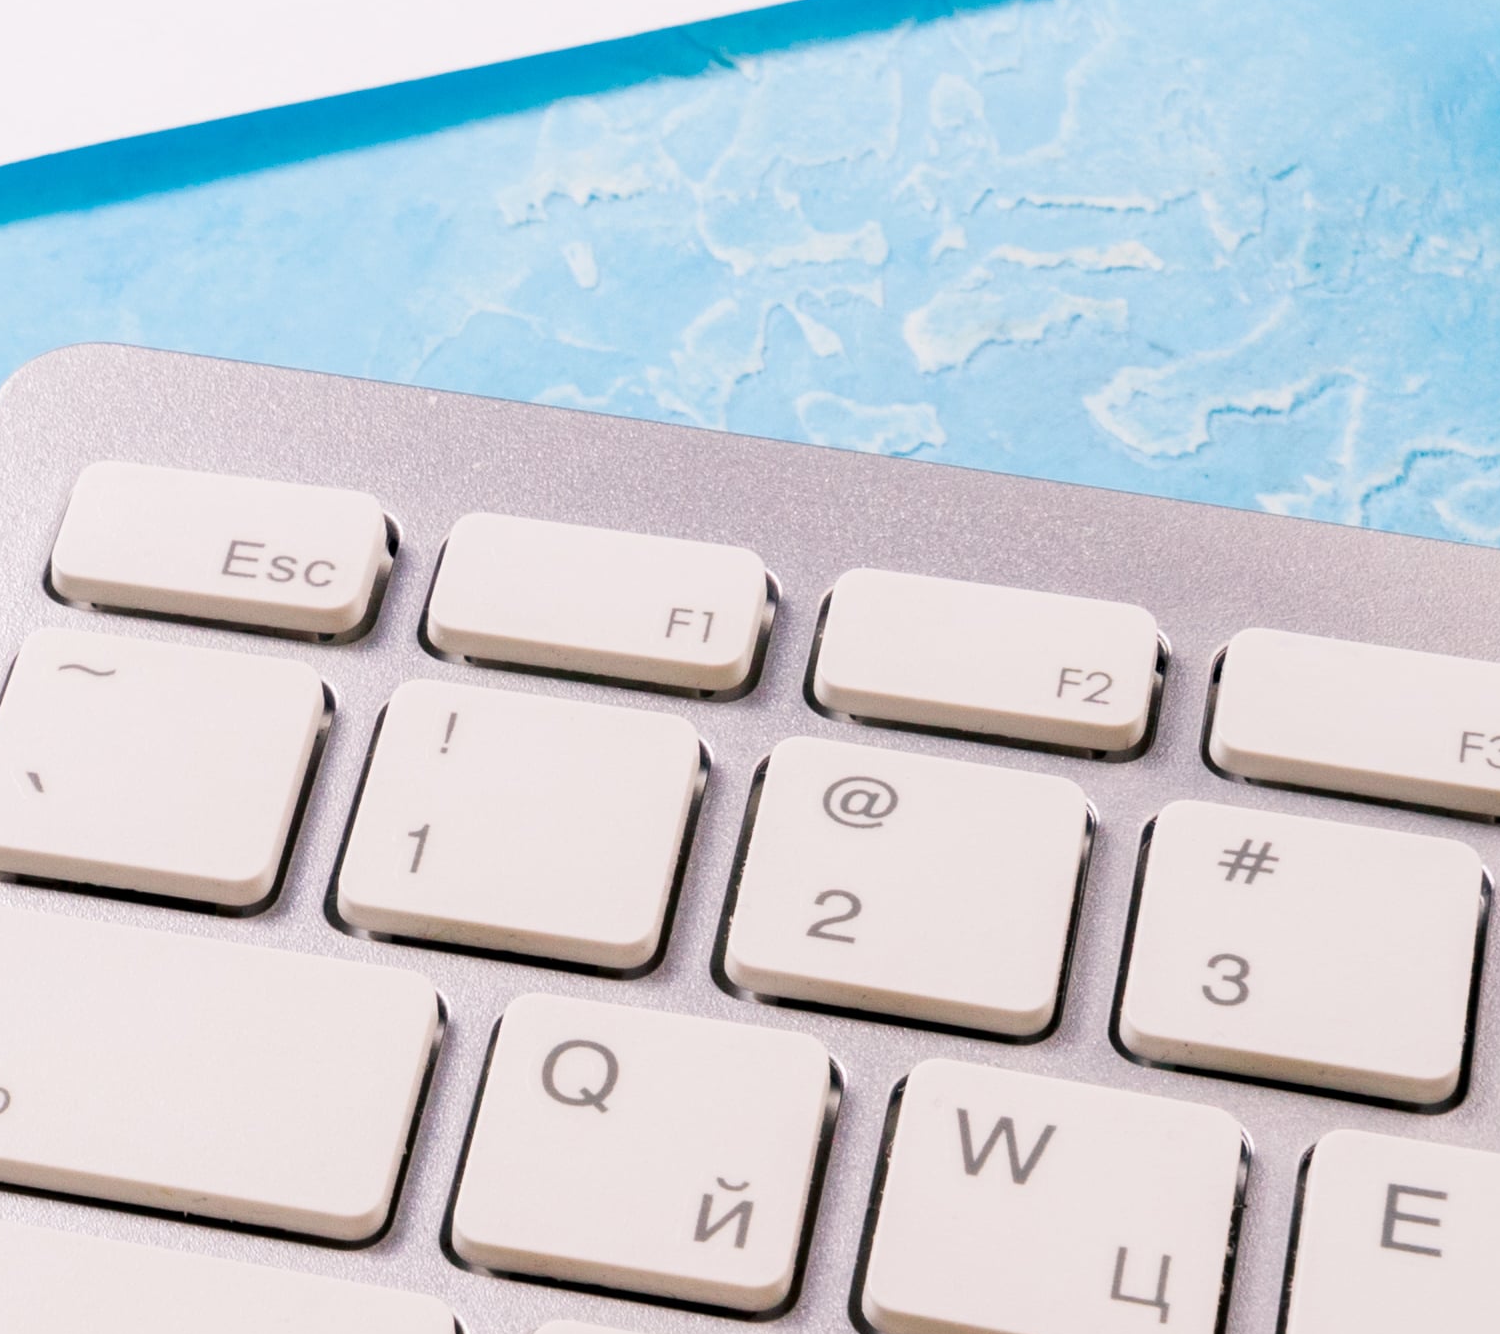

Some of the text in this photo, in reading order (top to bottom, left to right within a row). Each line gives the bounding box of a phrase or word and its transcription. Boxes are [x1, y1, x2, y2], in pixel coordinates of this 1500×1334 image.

[221, 540, 337, 589] Esc
[664, 607, 715, 644] F1
[1055, 666, 1114, 706] F2
[439, 711, 458, 755] !
[822, 775, 899, 830] @
[408, 823, 430, 874] 1
[1218, 838, 1279, 885] #
[806, 889, 863, 944] 2
[1201, 952, 1251, 1007] 3
[541, 1039, 620, 1114] Q
[956, 1108, 1057, 1186] W
[1380, 1183, 1448, 1258] E
